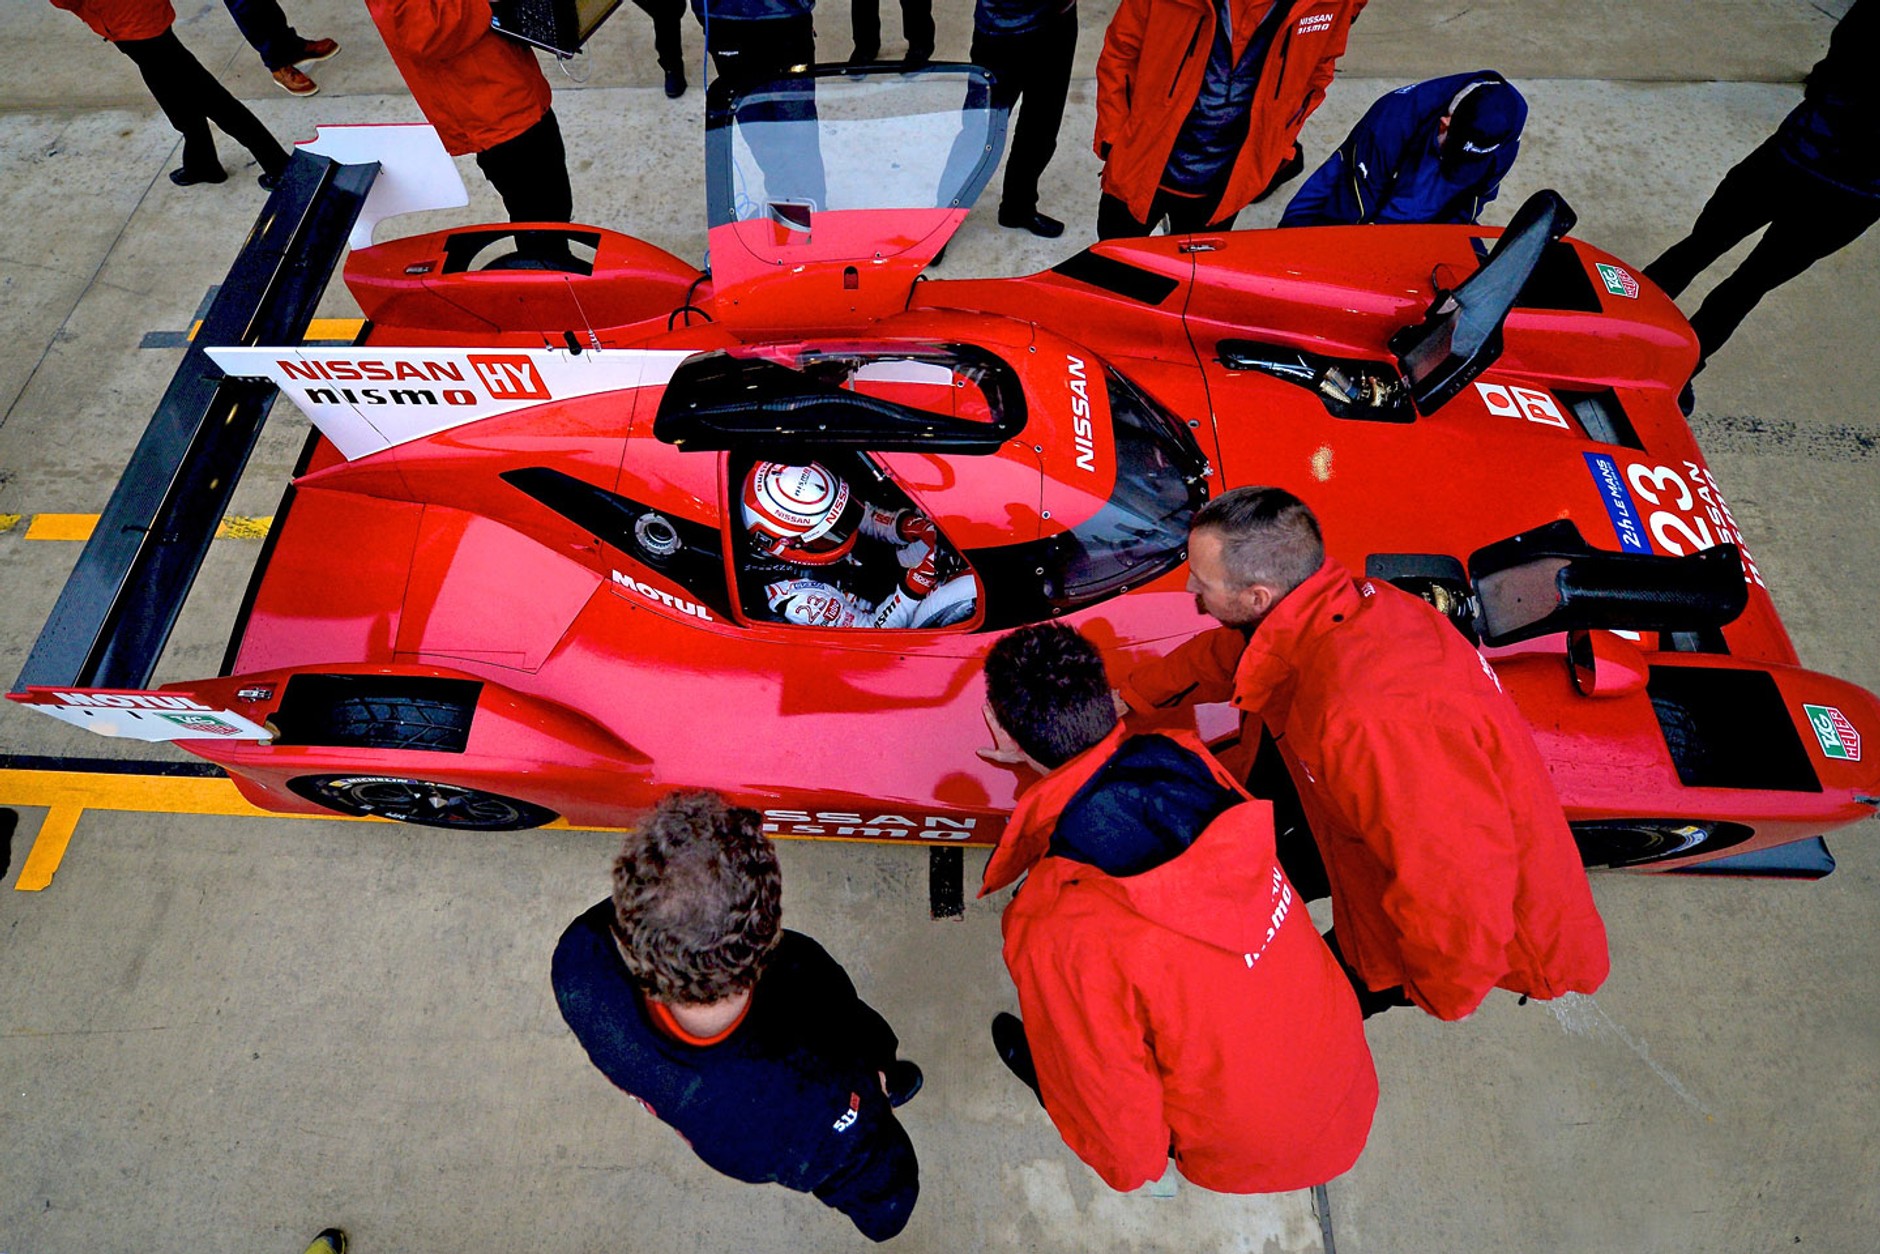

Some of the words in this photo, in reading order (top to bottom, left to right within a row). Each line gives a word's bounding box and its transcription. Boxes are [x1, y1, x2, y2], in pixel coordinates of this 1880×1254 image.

[1299, 13, 1334, 26] NISSAN
[276, 360, 466, 381] NISSAN
[476, 362, 539, 394] HY
[305, 388, 478, 405] nismo
[1517, 390, 1562, 424] P1
[1066, 354, 1095, 472] NISSAN
[1596, 458, 1622, 498] MANS
[774, 509, 811, 525] NISSAN
[825, 480, 849, 526] NISSA
[1613, 498, 1629, 517] LE
[1626, 463, 1715, 557] 23
[612, 569, 713, 622] MOTUL
[795, 594, 828, 624] 23
[52, 692, 213, 711] MOTUL
[1813, 713, 1841, 749] TAG
[1830, 710, 1858, 757] HEUER
[762, 823, 972, 840] ismo
[763, 809, 977, 829] SSAN
